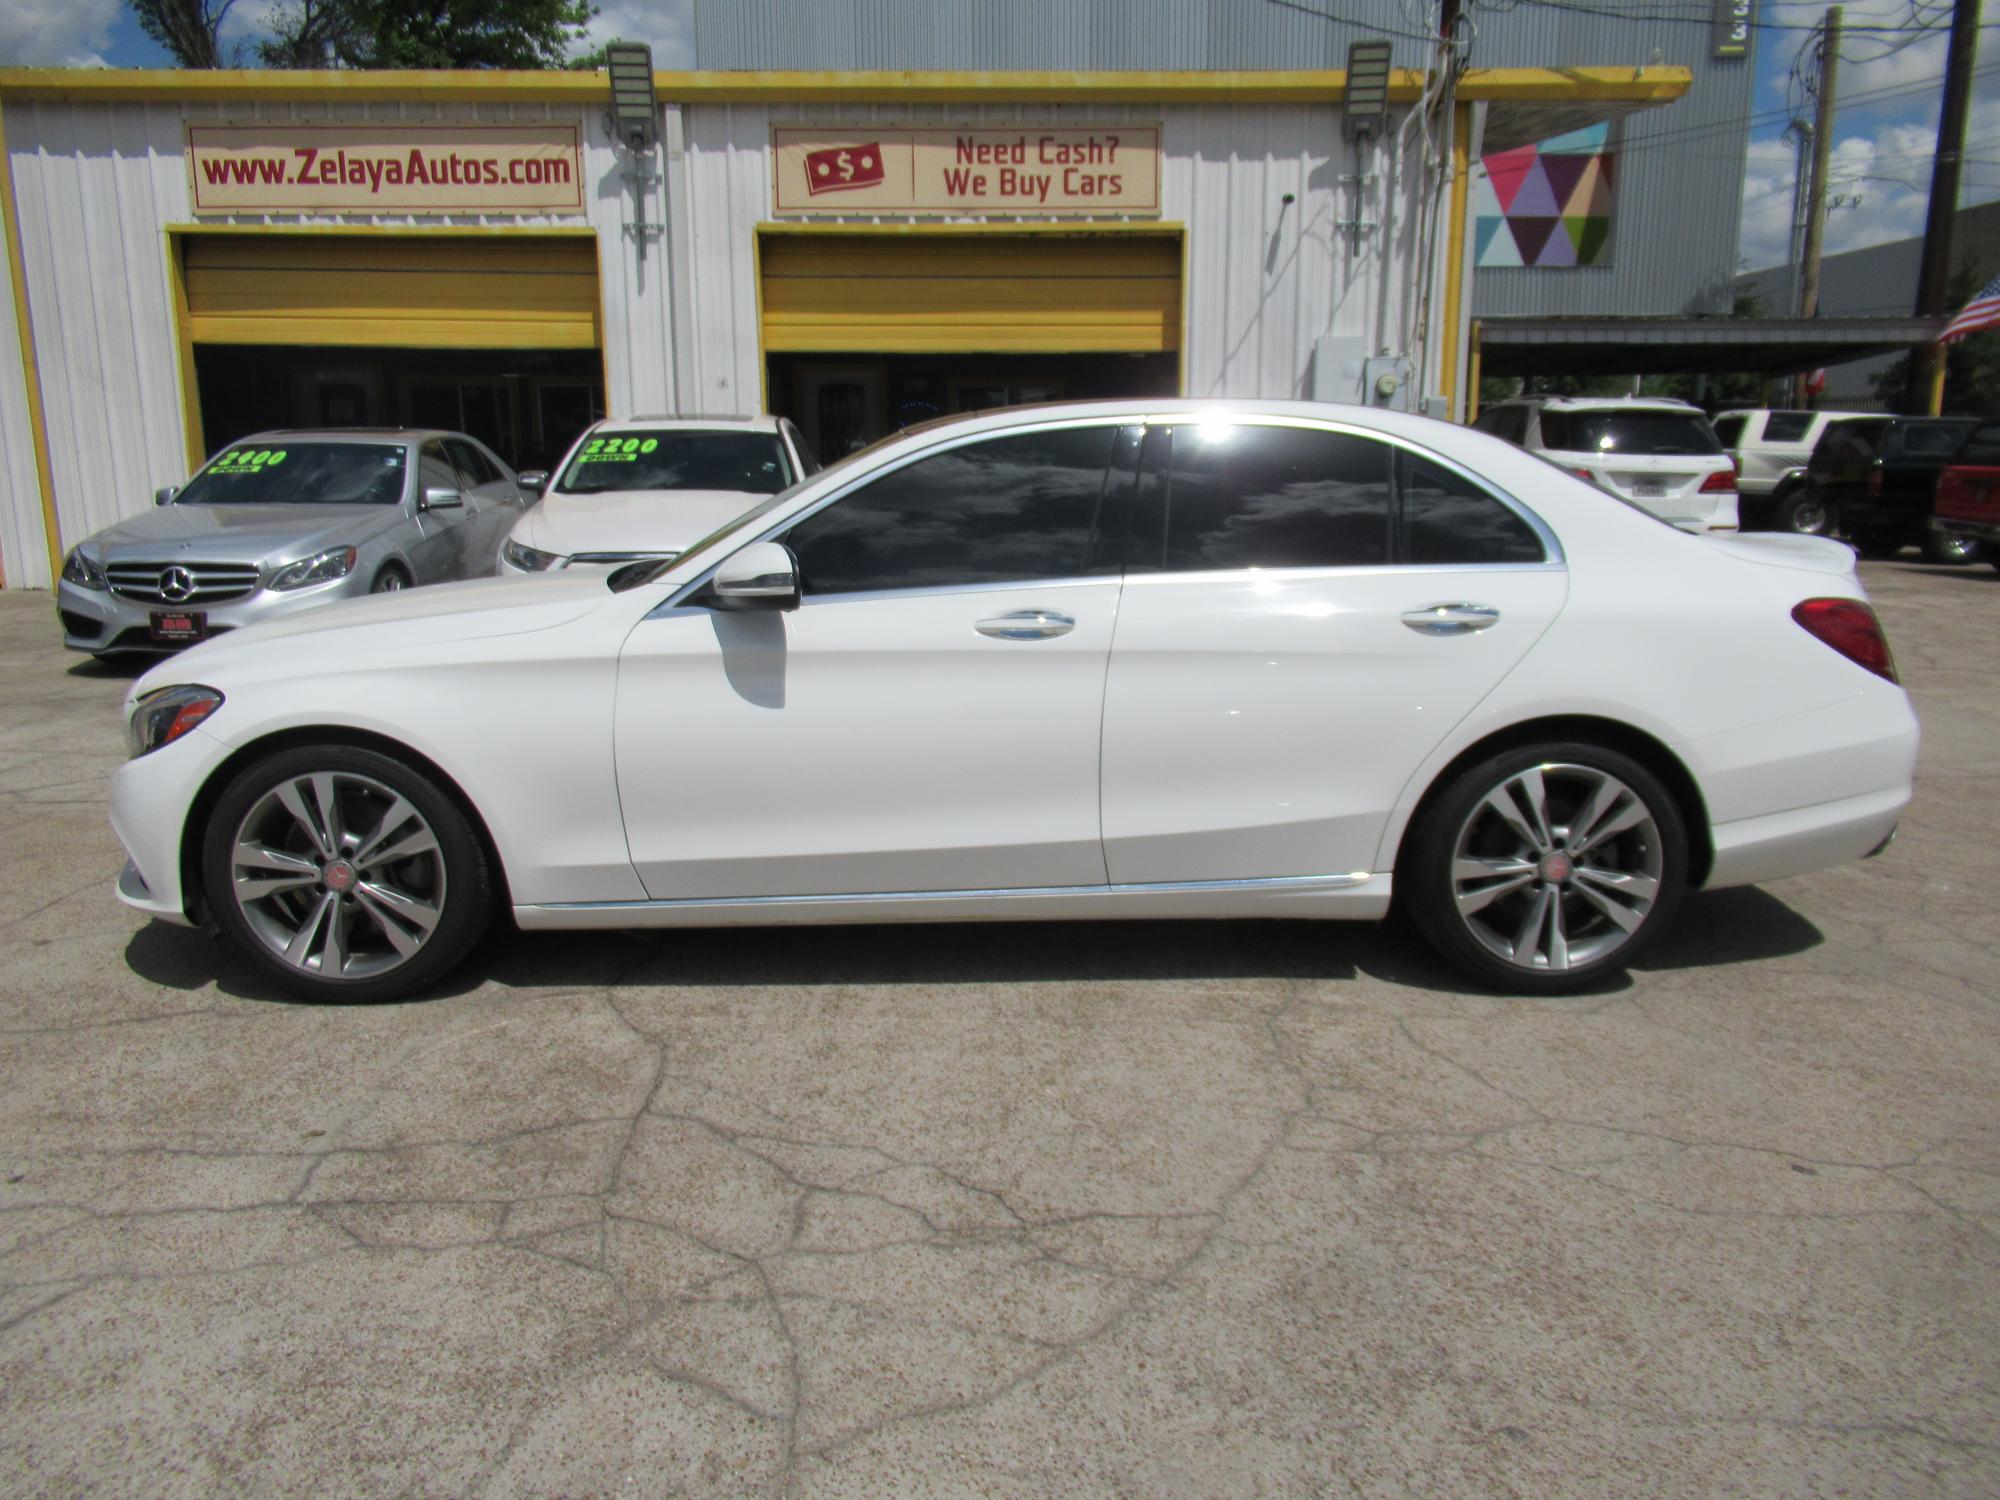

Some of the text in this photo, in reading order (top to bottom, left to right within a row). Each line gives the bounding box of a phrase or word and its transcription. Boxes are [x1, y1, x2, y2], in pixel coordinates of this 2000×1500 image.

[956, 136, 1120, 164] Need Cash?
[202, 148, 571, 193] www.ZelayaAutos.com
[944, 167, 1122, 203] We Buy Cars
[585, 438, 658, 454] 2200
